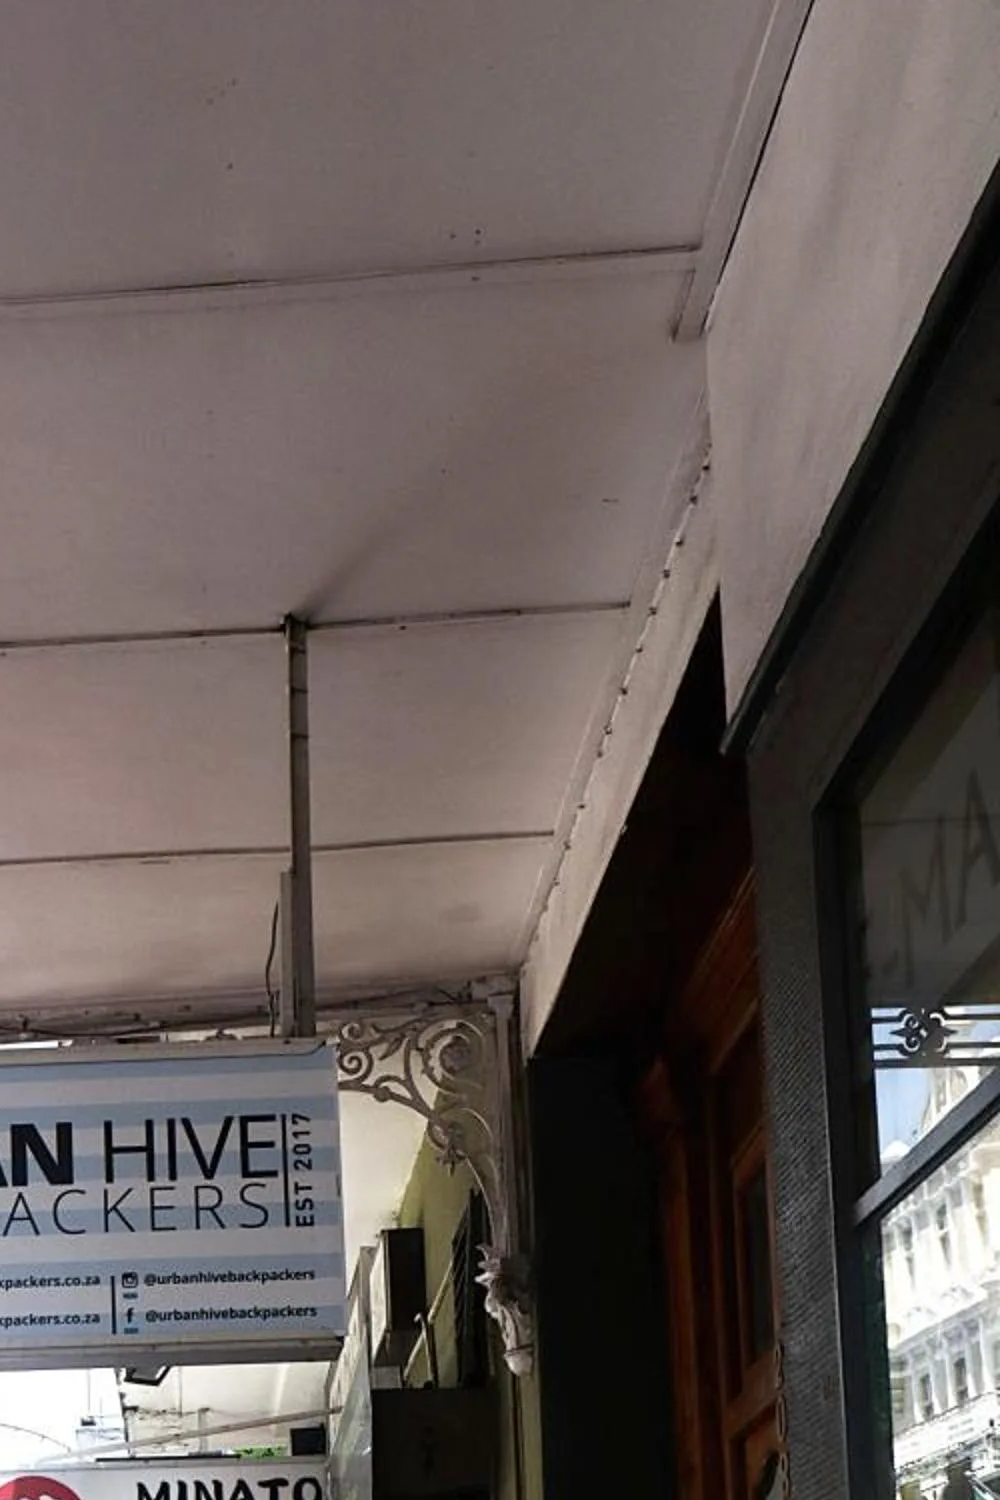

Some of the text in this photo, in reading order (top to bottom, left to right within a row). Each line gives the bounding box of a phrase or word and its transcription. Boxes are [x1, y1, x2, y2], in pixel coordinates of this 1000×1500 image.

[103, 1113, 279, 1184] HIVE
[291, 1113, 315, 1228] EST 2017
[143, 1269, 316, 1286] @urbanhivebackpackers
[145, 1305, 318, 1323] @urbanhivebackpackers
